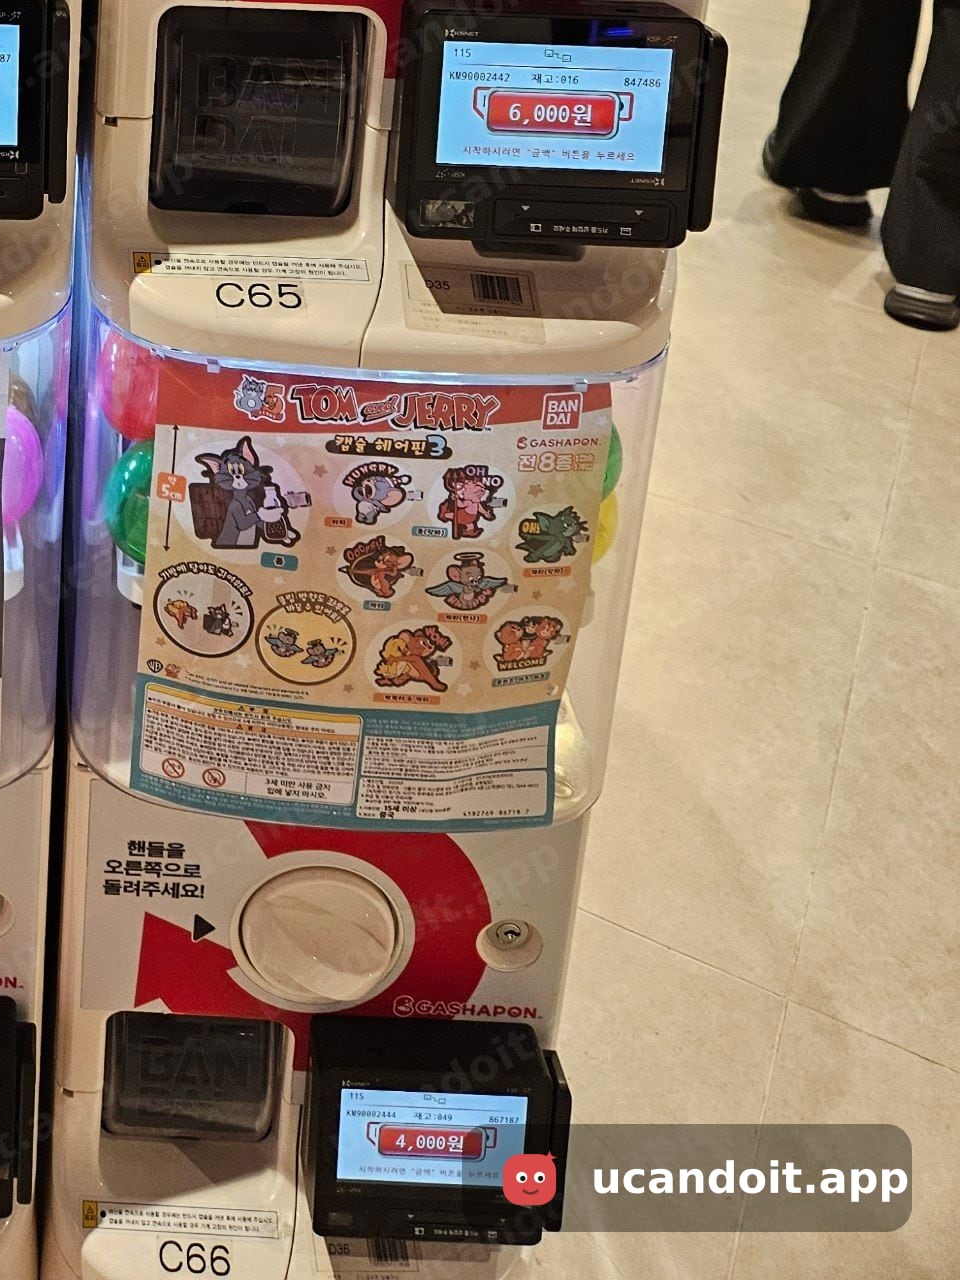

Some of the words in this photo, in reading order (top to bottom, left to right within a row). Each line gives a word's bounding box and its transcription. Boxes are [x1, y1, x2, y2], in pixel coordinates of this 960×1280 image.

[454, 48, 471, 58] 115
[449, 71, 510, 82] KM90002442
[624, 77, 661, 87] 847486
[509, 103, 592, 127] 6,000원
[215, 282, 302, 308] C65
[291, 386, 358, 422] TOM
[390, 392, 500, 431] JERRY
[548, 400, 578, 413] BAN
[546, 413, 570, 425] DAI
[344, 463, 395, 487] HUNGRY
[467, 467, 485, 475] OH
[483, 477, 500, 487] NO
[161, 485, 182, 501] 5cm
[499, 658, 545, 670] WELCOME
[127, 840, 186, 859] 핸들을
[104, 859, 202, 879] 오른쪽으로
[103, 879, 205, 900] 돌려주세요!
[349, 1092, 365, 1101] 115
[395, 1134, 464, 1154] 4,000원
[159, 1240, 231, 1276] C66
